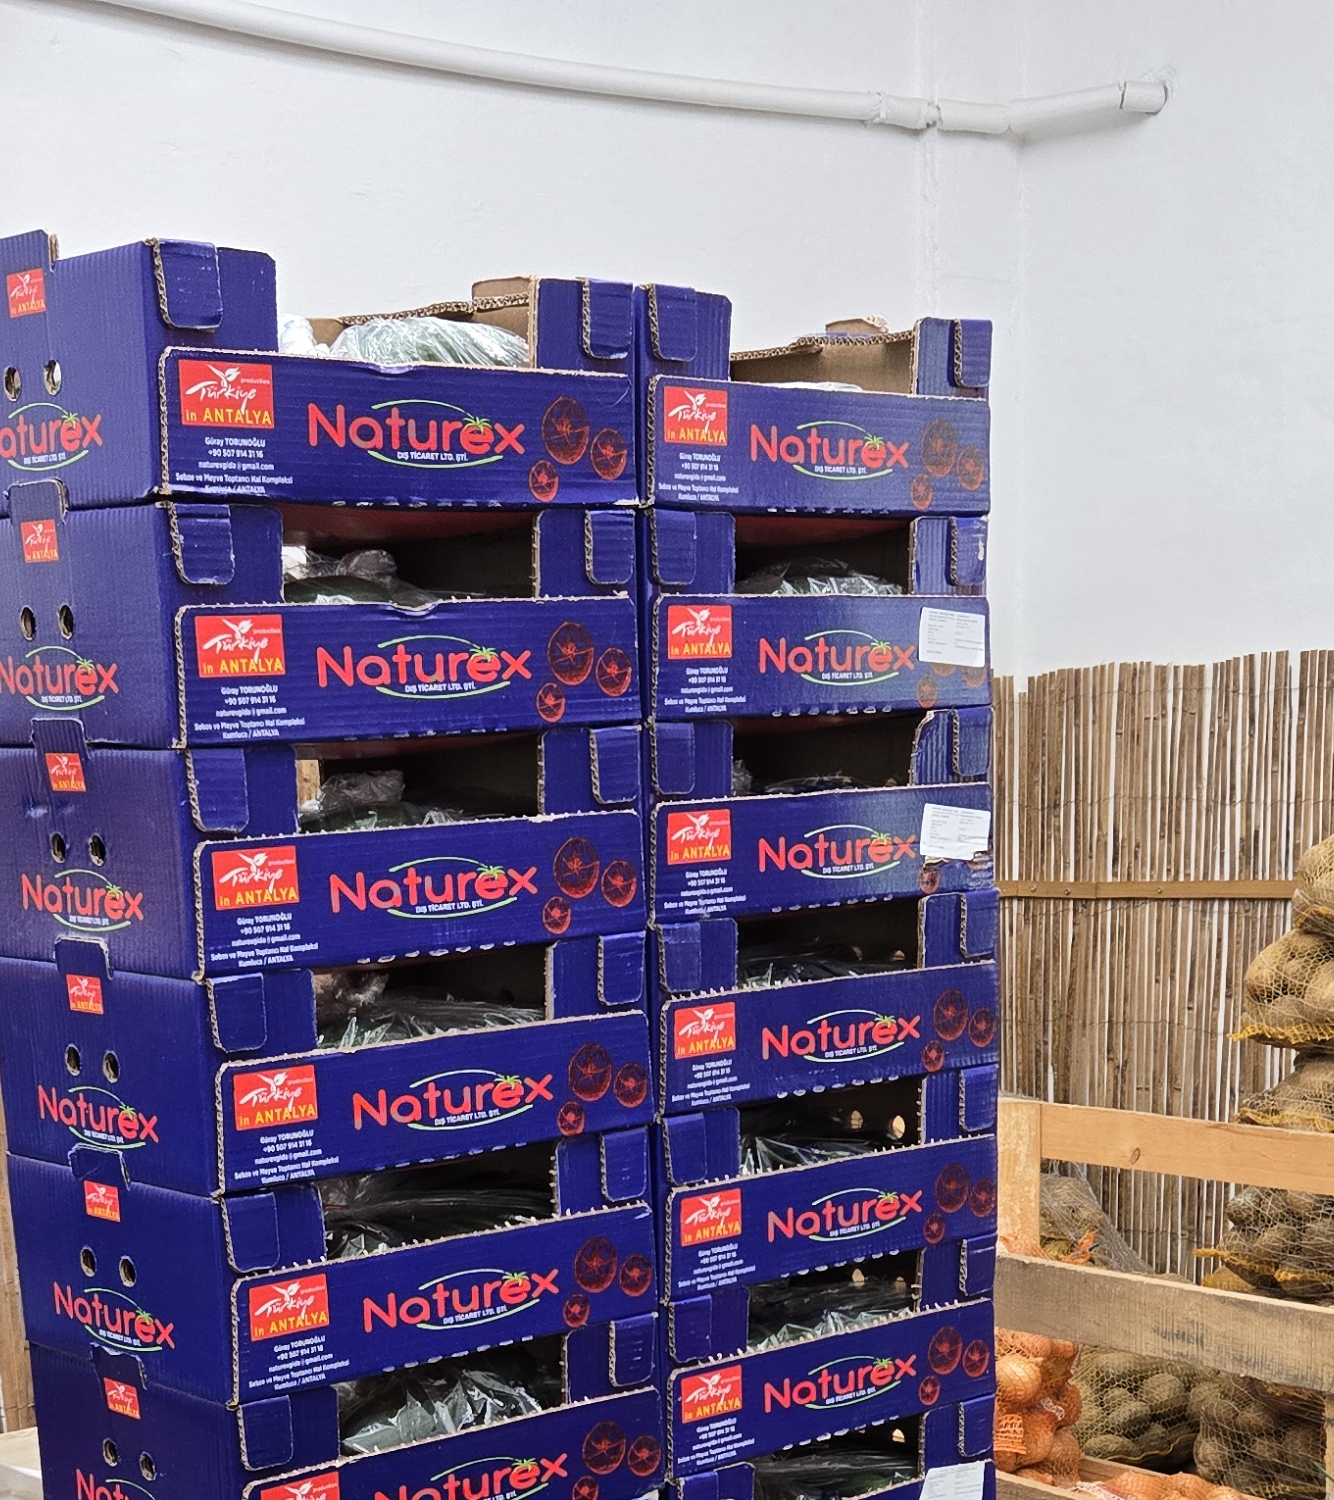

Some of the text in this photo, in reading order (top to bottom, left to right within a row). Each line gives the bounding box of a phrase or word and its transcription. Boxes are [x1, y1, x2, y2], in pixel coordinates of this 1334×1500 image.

[186, 408, 272, 425] in ANTALYA
[308, 403, 524, 454] Naturex
[679, 428, 726, 443] ANTALYA
[750, 425, 908, 468] Naturex
[203, 657, 284, 674] in ANTALYA
[317, 644, 531, 687] Naturex
[683, 642, 730, 655] ANTALYA
[759, 638, 913, 673] Naturex
[683, 845, 730, 860] ANTALYA
[759, 834, 913, 871] Naturex
[21, 875, 143, 920] Naturex
[219, 886, 298, 906] in ANTALYA
[330, 867, 537, 913] Naturex
[689, 1036, 734, 1053] ANTALYA
[762, 1016, 920, 1059] Naturex
[38, 1086, 158, 1141] Naturex
[240, 1103, 316, 1126] in ANTALYA
[353, 1074, 553, 1129] Naturex
[696, 1222, 740, 1239] ANTALYA
[768, 1191, 922, 1241] Naturex
[54, 1284, 174, 1347] Naturex
[363, 1269, 558, 1332] Naturex
[255, 1310, 328, 1337] in ANTALYA
[764, 1356, 916, 1412] Naturex
[696, 1398, 741, 1417] ANTALYA
